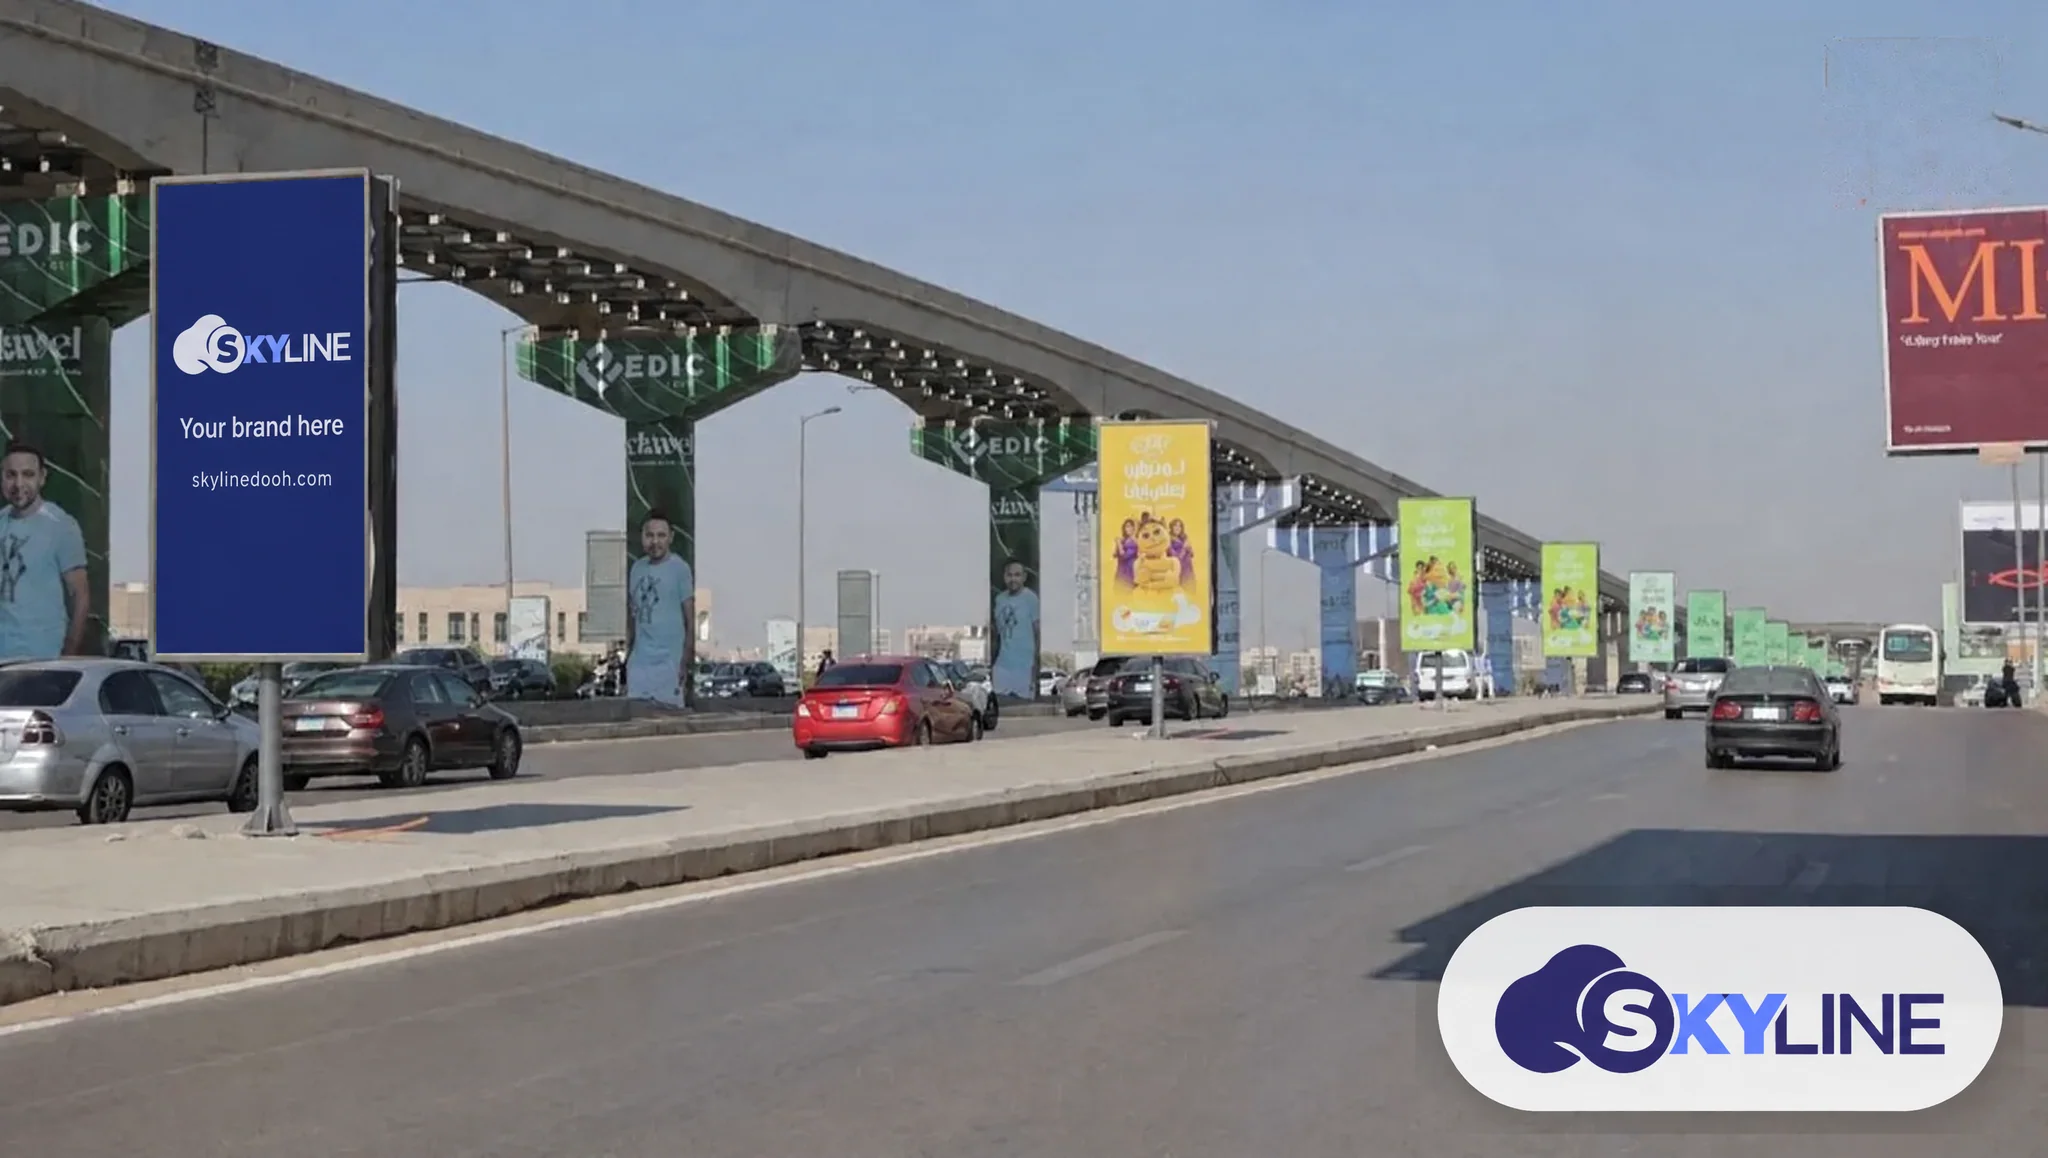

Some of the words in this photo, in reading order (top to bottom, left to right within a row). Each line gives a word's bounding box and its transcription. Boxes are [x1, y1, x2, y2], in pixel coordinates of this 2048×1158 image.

[1899, 239, 2048, 323] MI
[217, 332, 351, 364] SKYLINE
[624, 353, 704, 379] EDIC
[180, 417, 226, 439] Your
[232, 415, 291, 438] brand
[298, 414, 344, 436] here
[989, 436, 1049, 455] EDIC
[192, 470, 332, 491] skylinedooh.com
